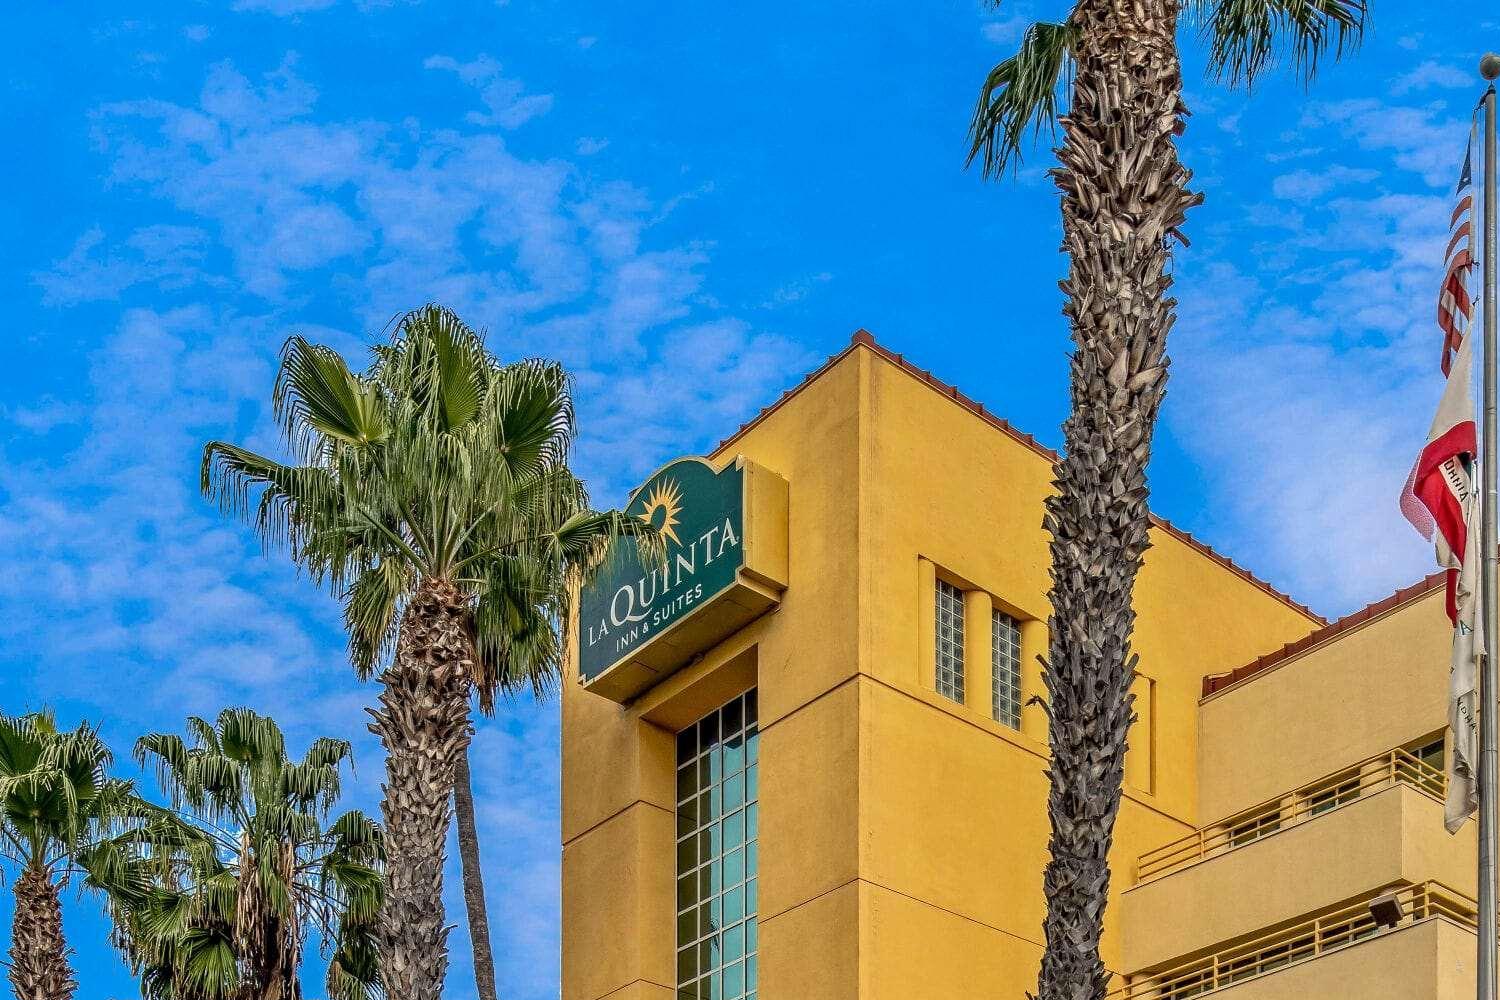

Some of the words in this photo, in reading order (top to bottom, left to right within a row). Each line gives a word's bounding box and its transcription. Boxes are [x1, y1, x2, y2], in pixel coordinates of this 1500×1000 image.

[587, 617, 610, 647] LA
[610, 517, 738, 627] QUINTA
[616, 627, 639, 653] INN
[642, 622, 650, 634] &
[653, 583, 703, 627] SUITES
